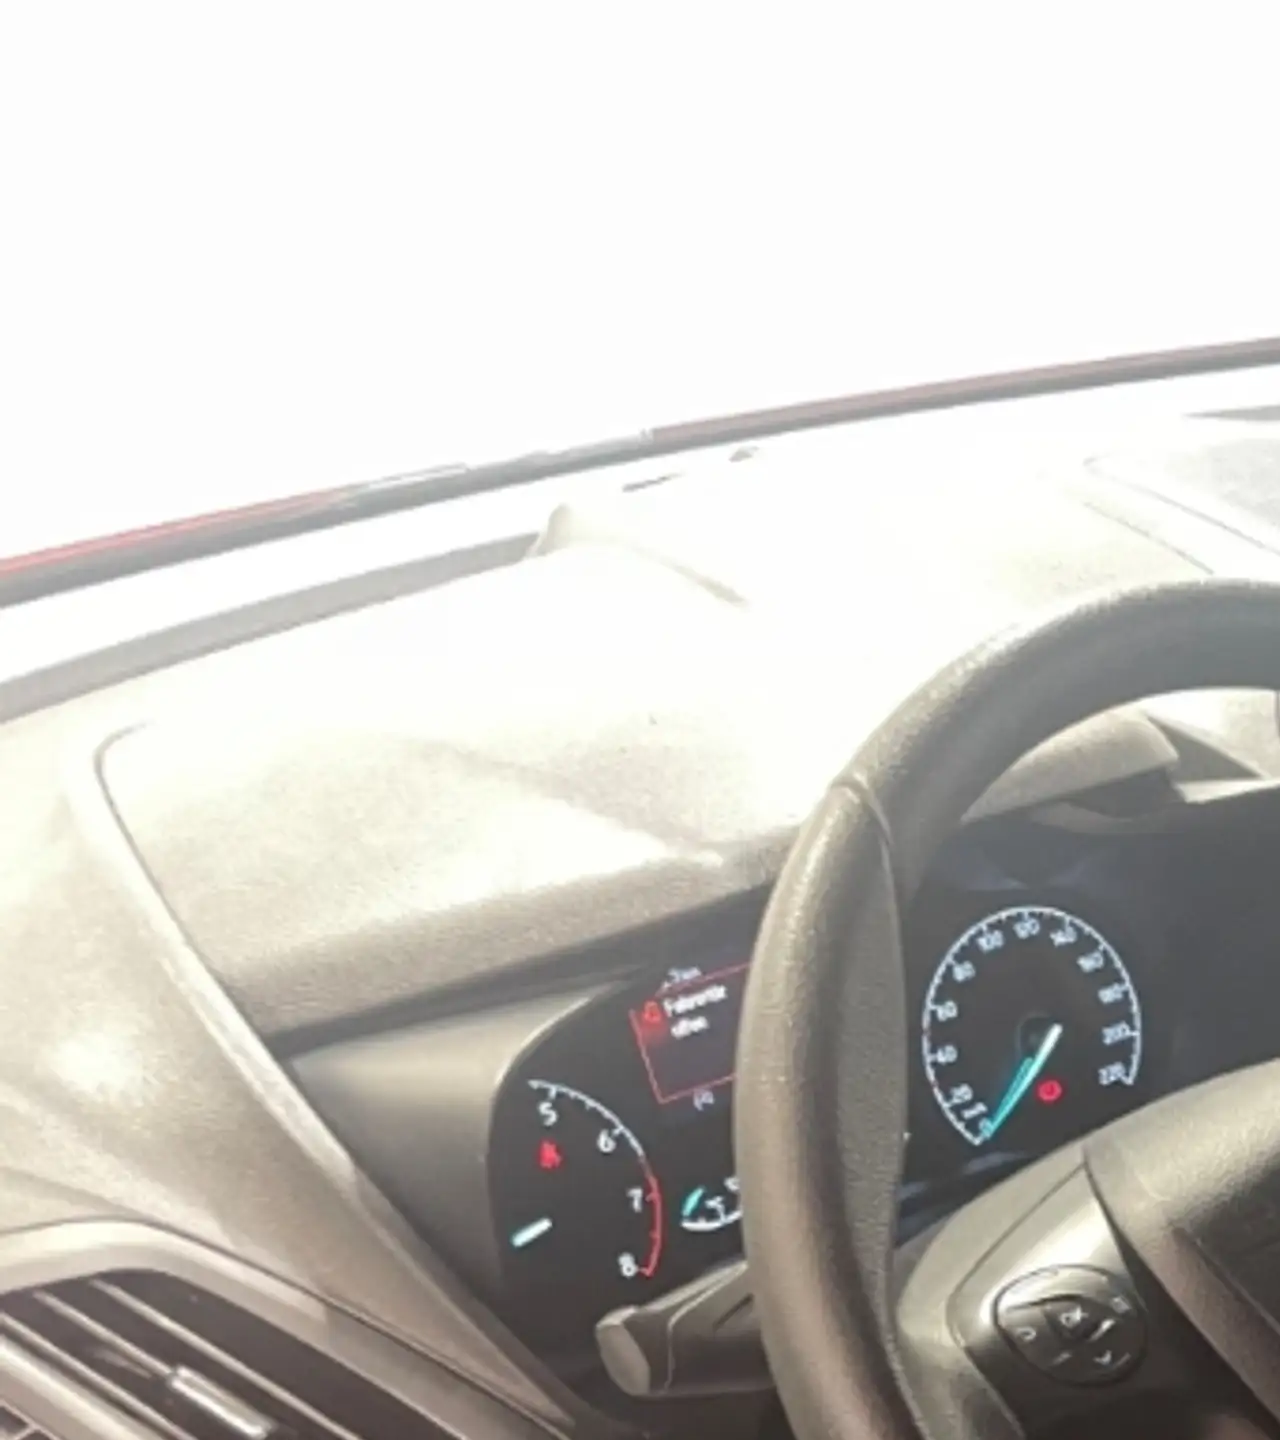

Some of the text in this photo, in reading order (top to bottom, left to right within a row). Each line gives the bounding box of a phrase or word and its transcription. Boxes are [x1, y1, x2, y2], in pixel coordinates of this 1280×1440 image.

[537, 1101, 559, 1127] 5
[597, 1129, 616, 1154] 6
[626, 1186, 644, 1213] 7
[618, 1252, 638, 1278] 8
